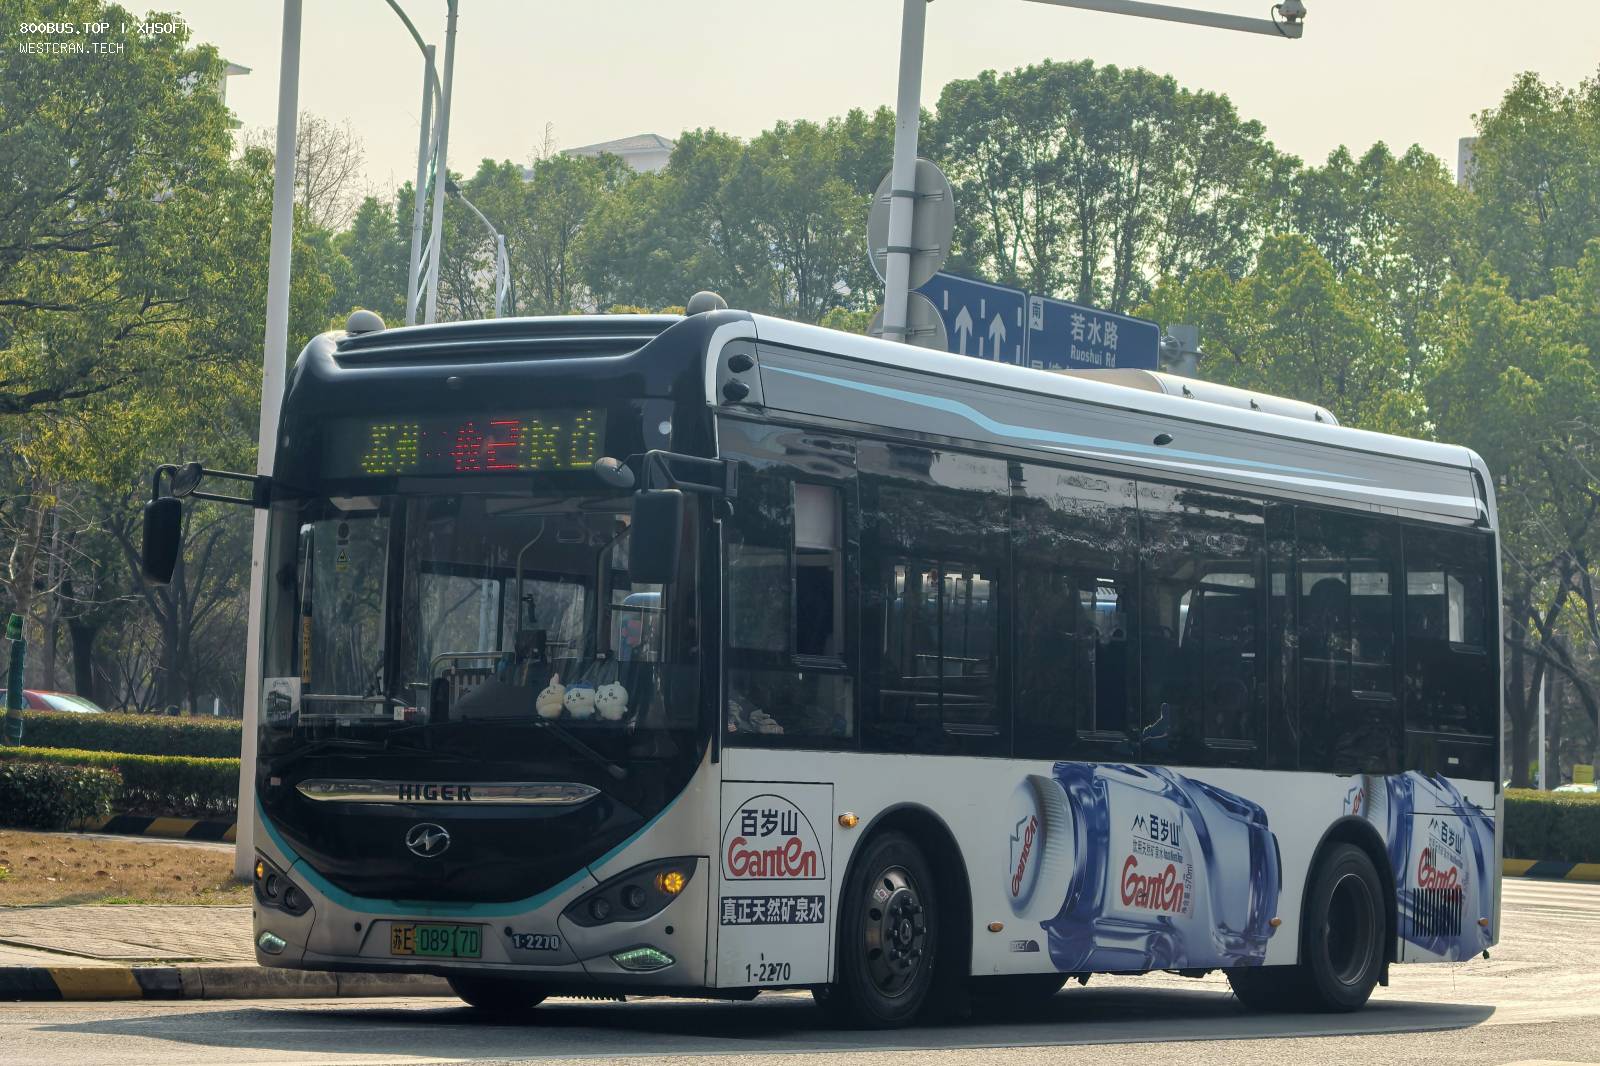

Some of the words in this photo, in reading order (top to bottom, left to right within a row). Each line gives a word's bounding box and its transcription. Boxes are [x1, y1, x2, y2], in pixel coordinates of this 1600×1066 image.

[1070, 312, 1119, 351] 若水路
[1070, 344, 1103, 366] Ruoshui
[1105, 352, 1116, 368] Rd
[398, 783, 473, 801] HIGER
[741, 808, 798, 837] 百岁山
[1150, 813, 1181, 848] 百岁山
[722, 897, 824, 924] 真正天然矿泉水
[745, 962, 791, 983] 1-2270
